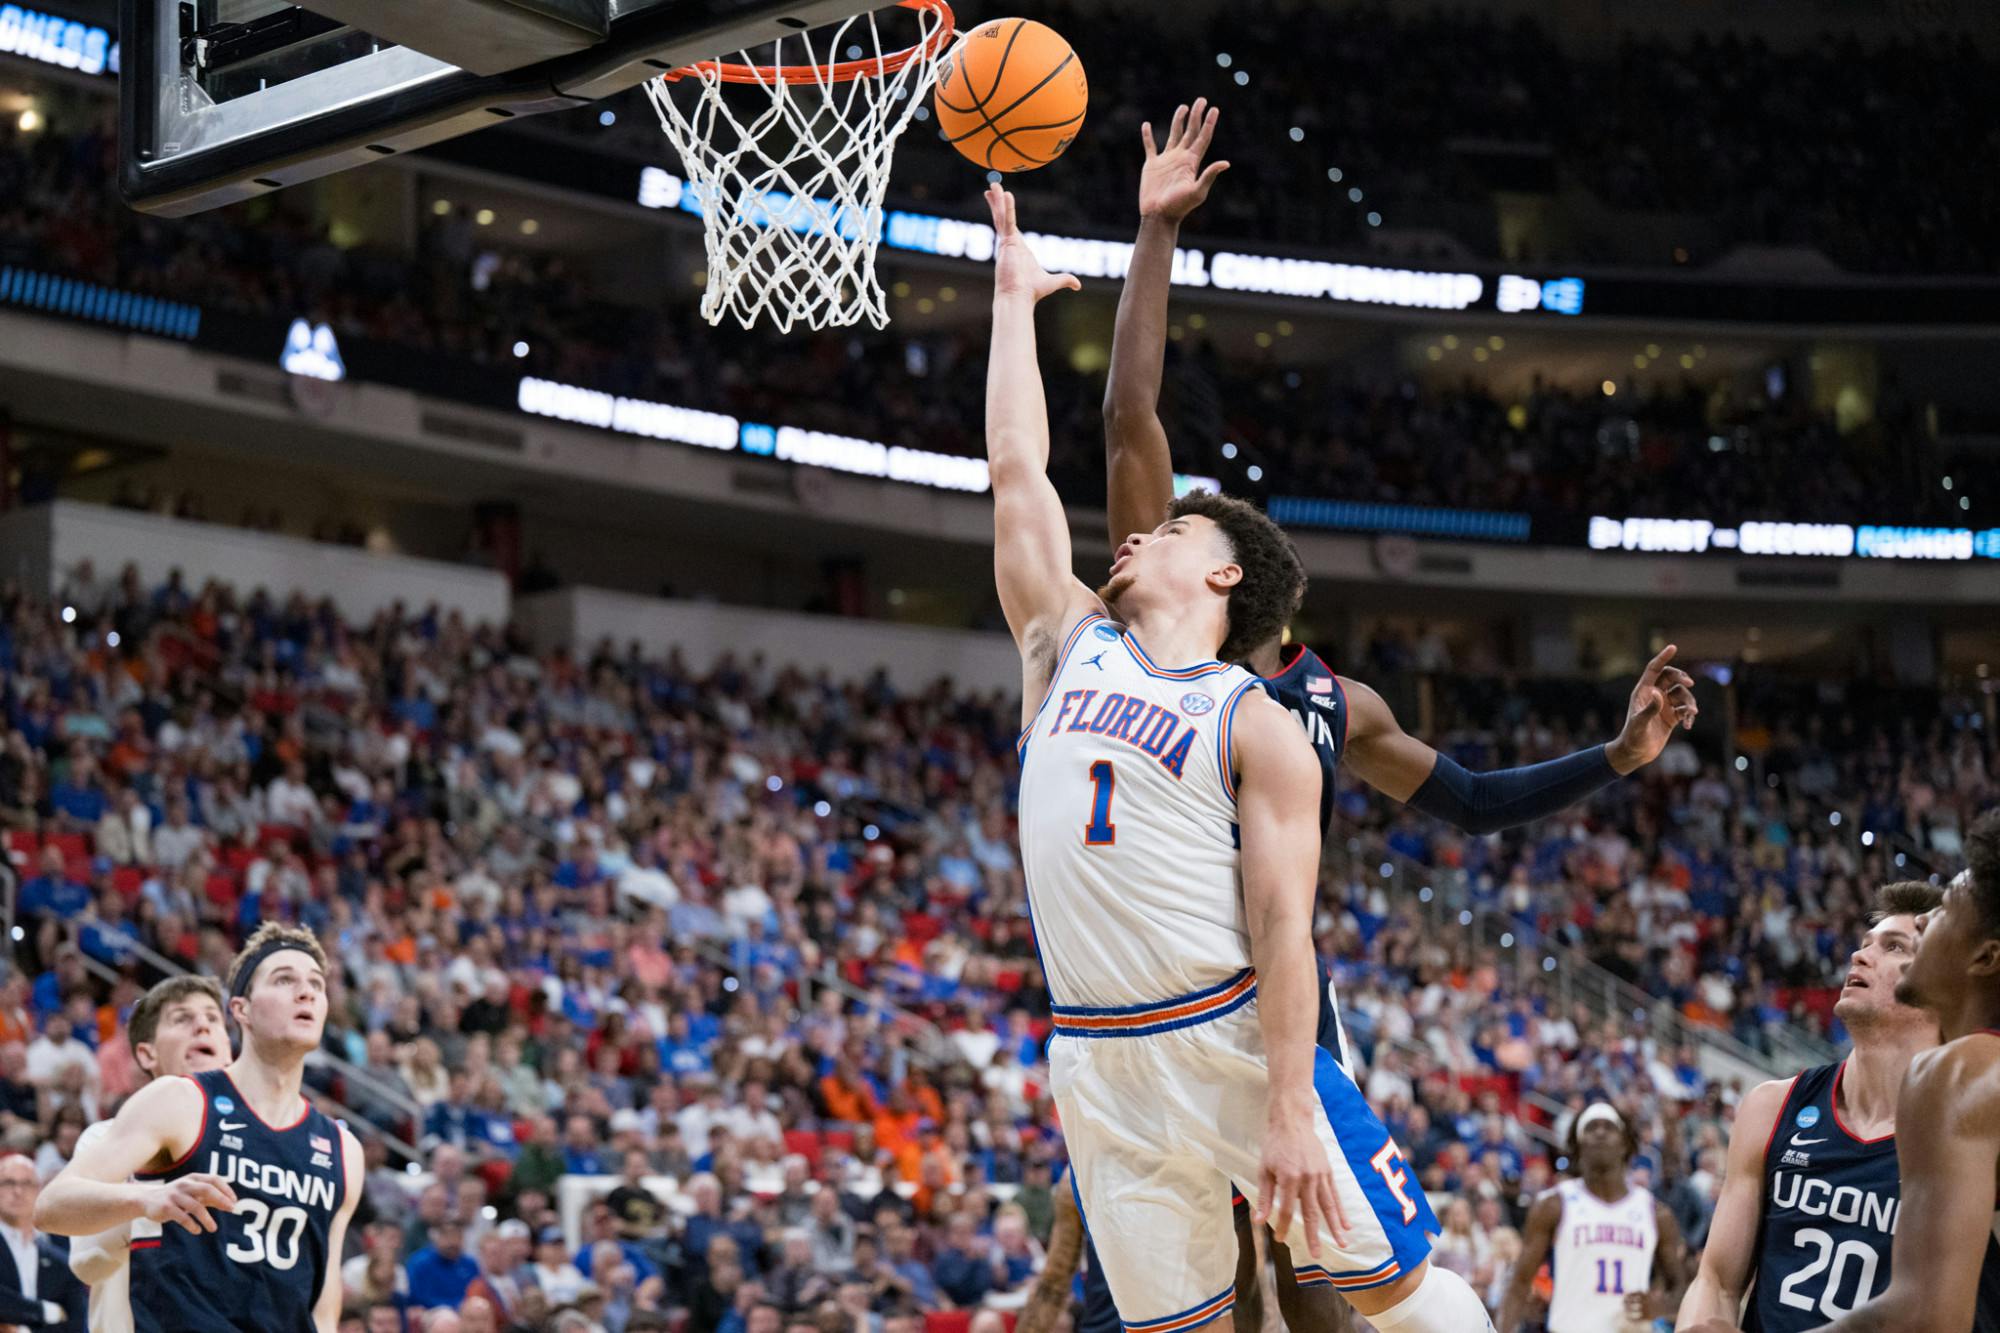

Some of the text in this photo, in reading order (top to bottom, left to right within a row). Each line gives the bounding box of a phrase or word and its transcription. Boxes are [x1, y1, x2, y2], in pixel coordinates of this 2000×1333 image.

[1049, 689, 1198, 781] FLORIDA
[1085, 760, 1116, 845] 1
[208, 1151, 336, 1211] UCONN
[1370, 1135, 1418, 1226] F
[226, 1198, 309, 1270] 30
[1573, 1223, 1645, 1249] FLORIDA
[1596, 1258, 1624, 1294] 11
[1779, 1228, 1879, 1322] 20
